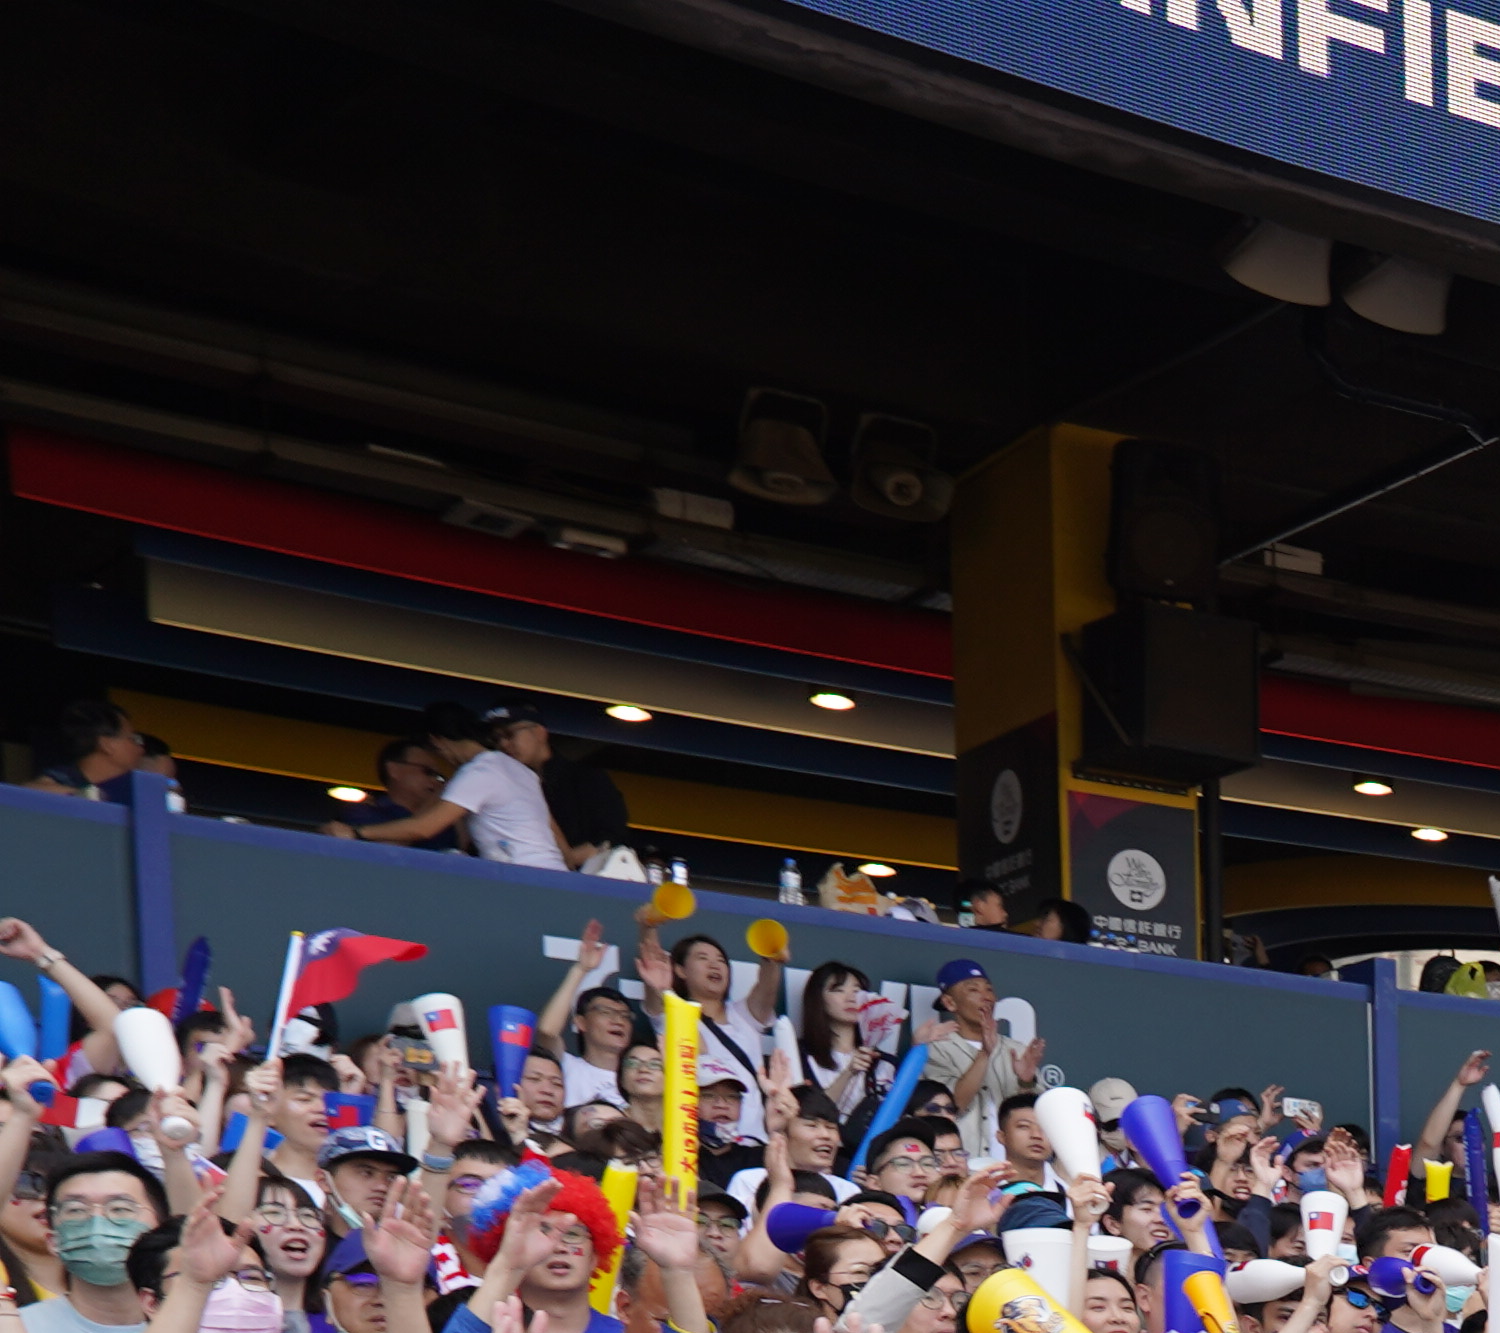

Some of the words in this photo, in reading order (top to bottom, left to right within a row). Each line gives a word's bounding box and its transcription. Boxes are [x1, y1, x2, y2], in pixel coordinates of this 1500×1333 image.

[1093, 914, 1183, 938] 中國信託銀行
[1138, 939, 1178, 957] BANK
